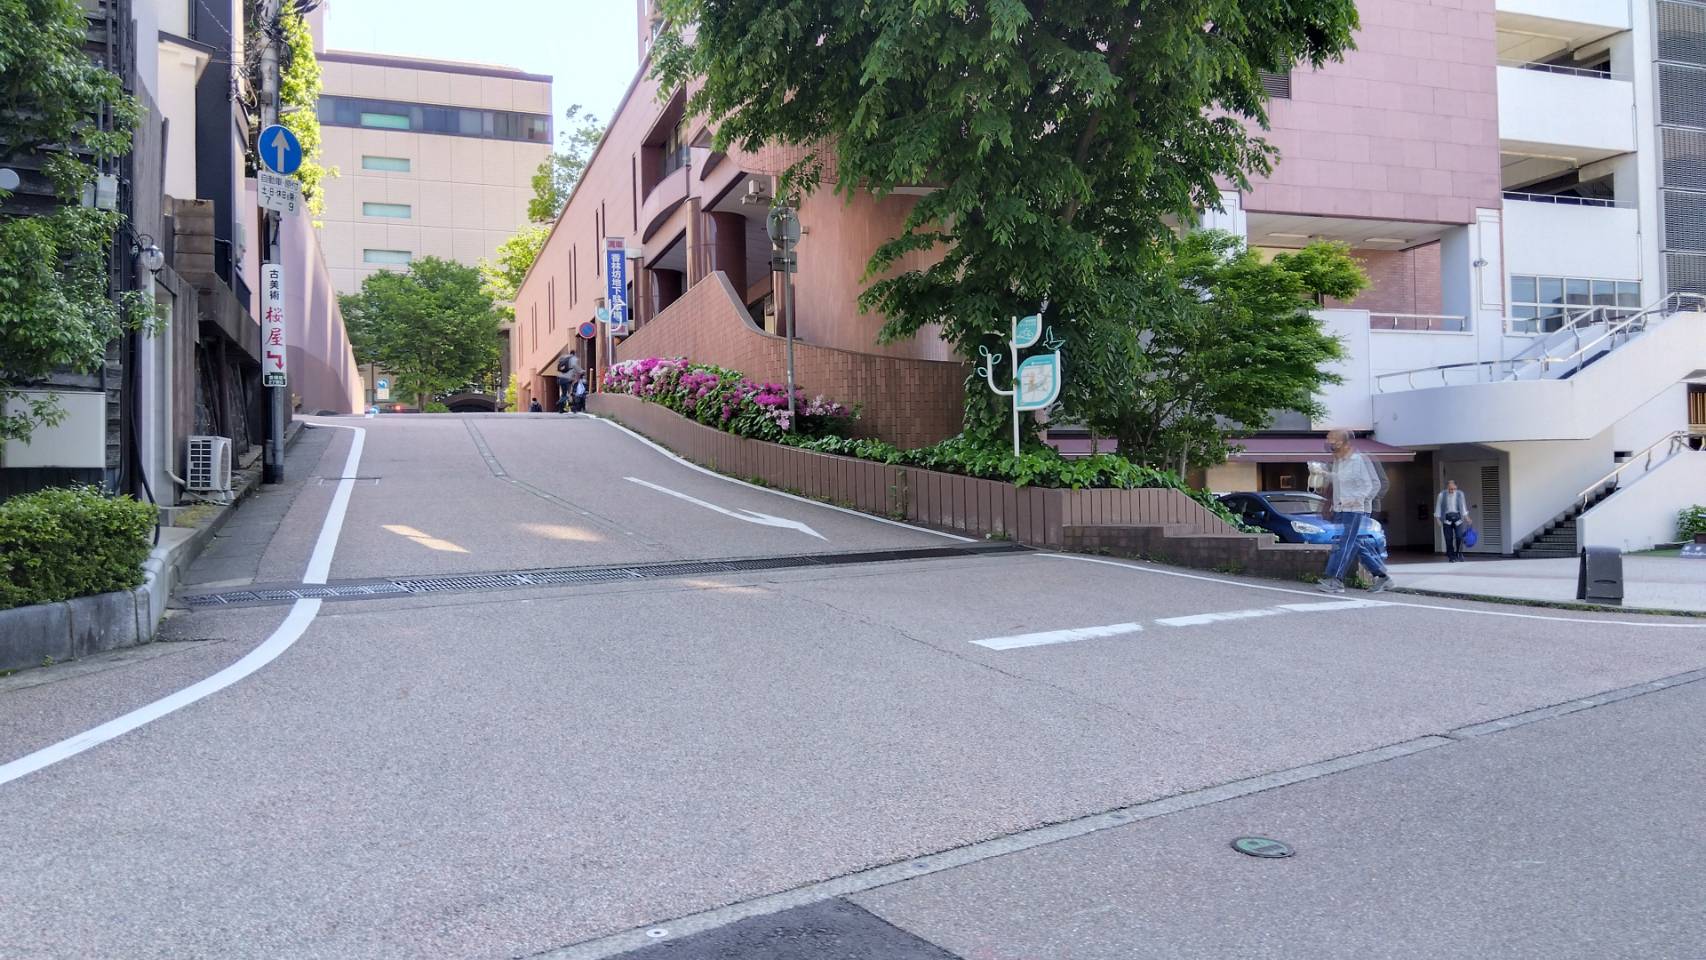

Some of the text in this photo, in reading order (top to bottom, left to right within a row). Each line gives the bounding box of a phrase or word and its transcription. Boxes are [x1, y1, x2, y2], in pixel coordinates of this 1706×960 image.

[265, 269, 284, 346] 古美術 桜屋
